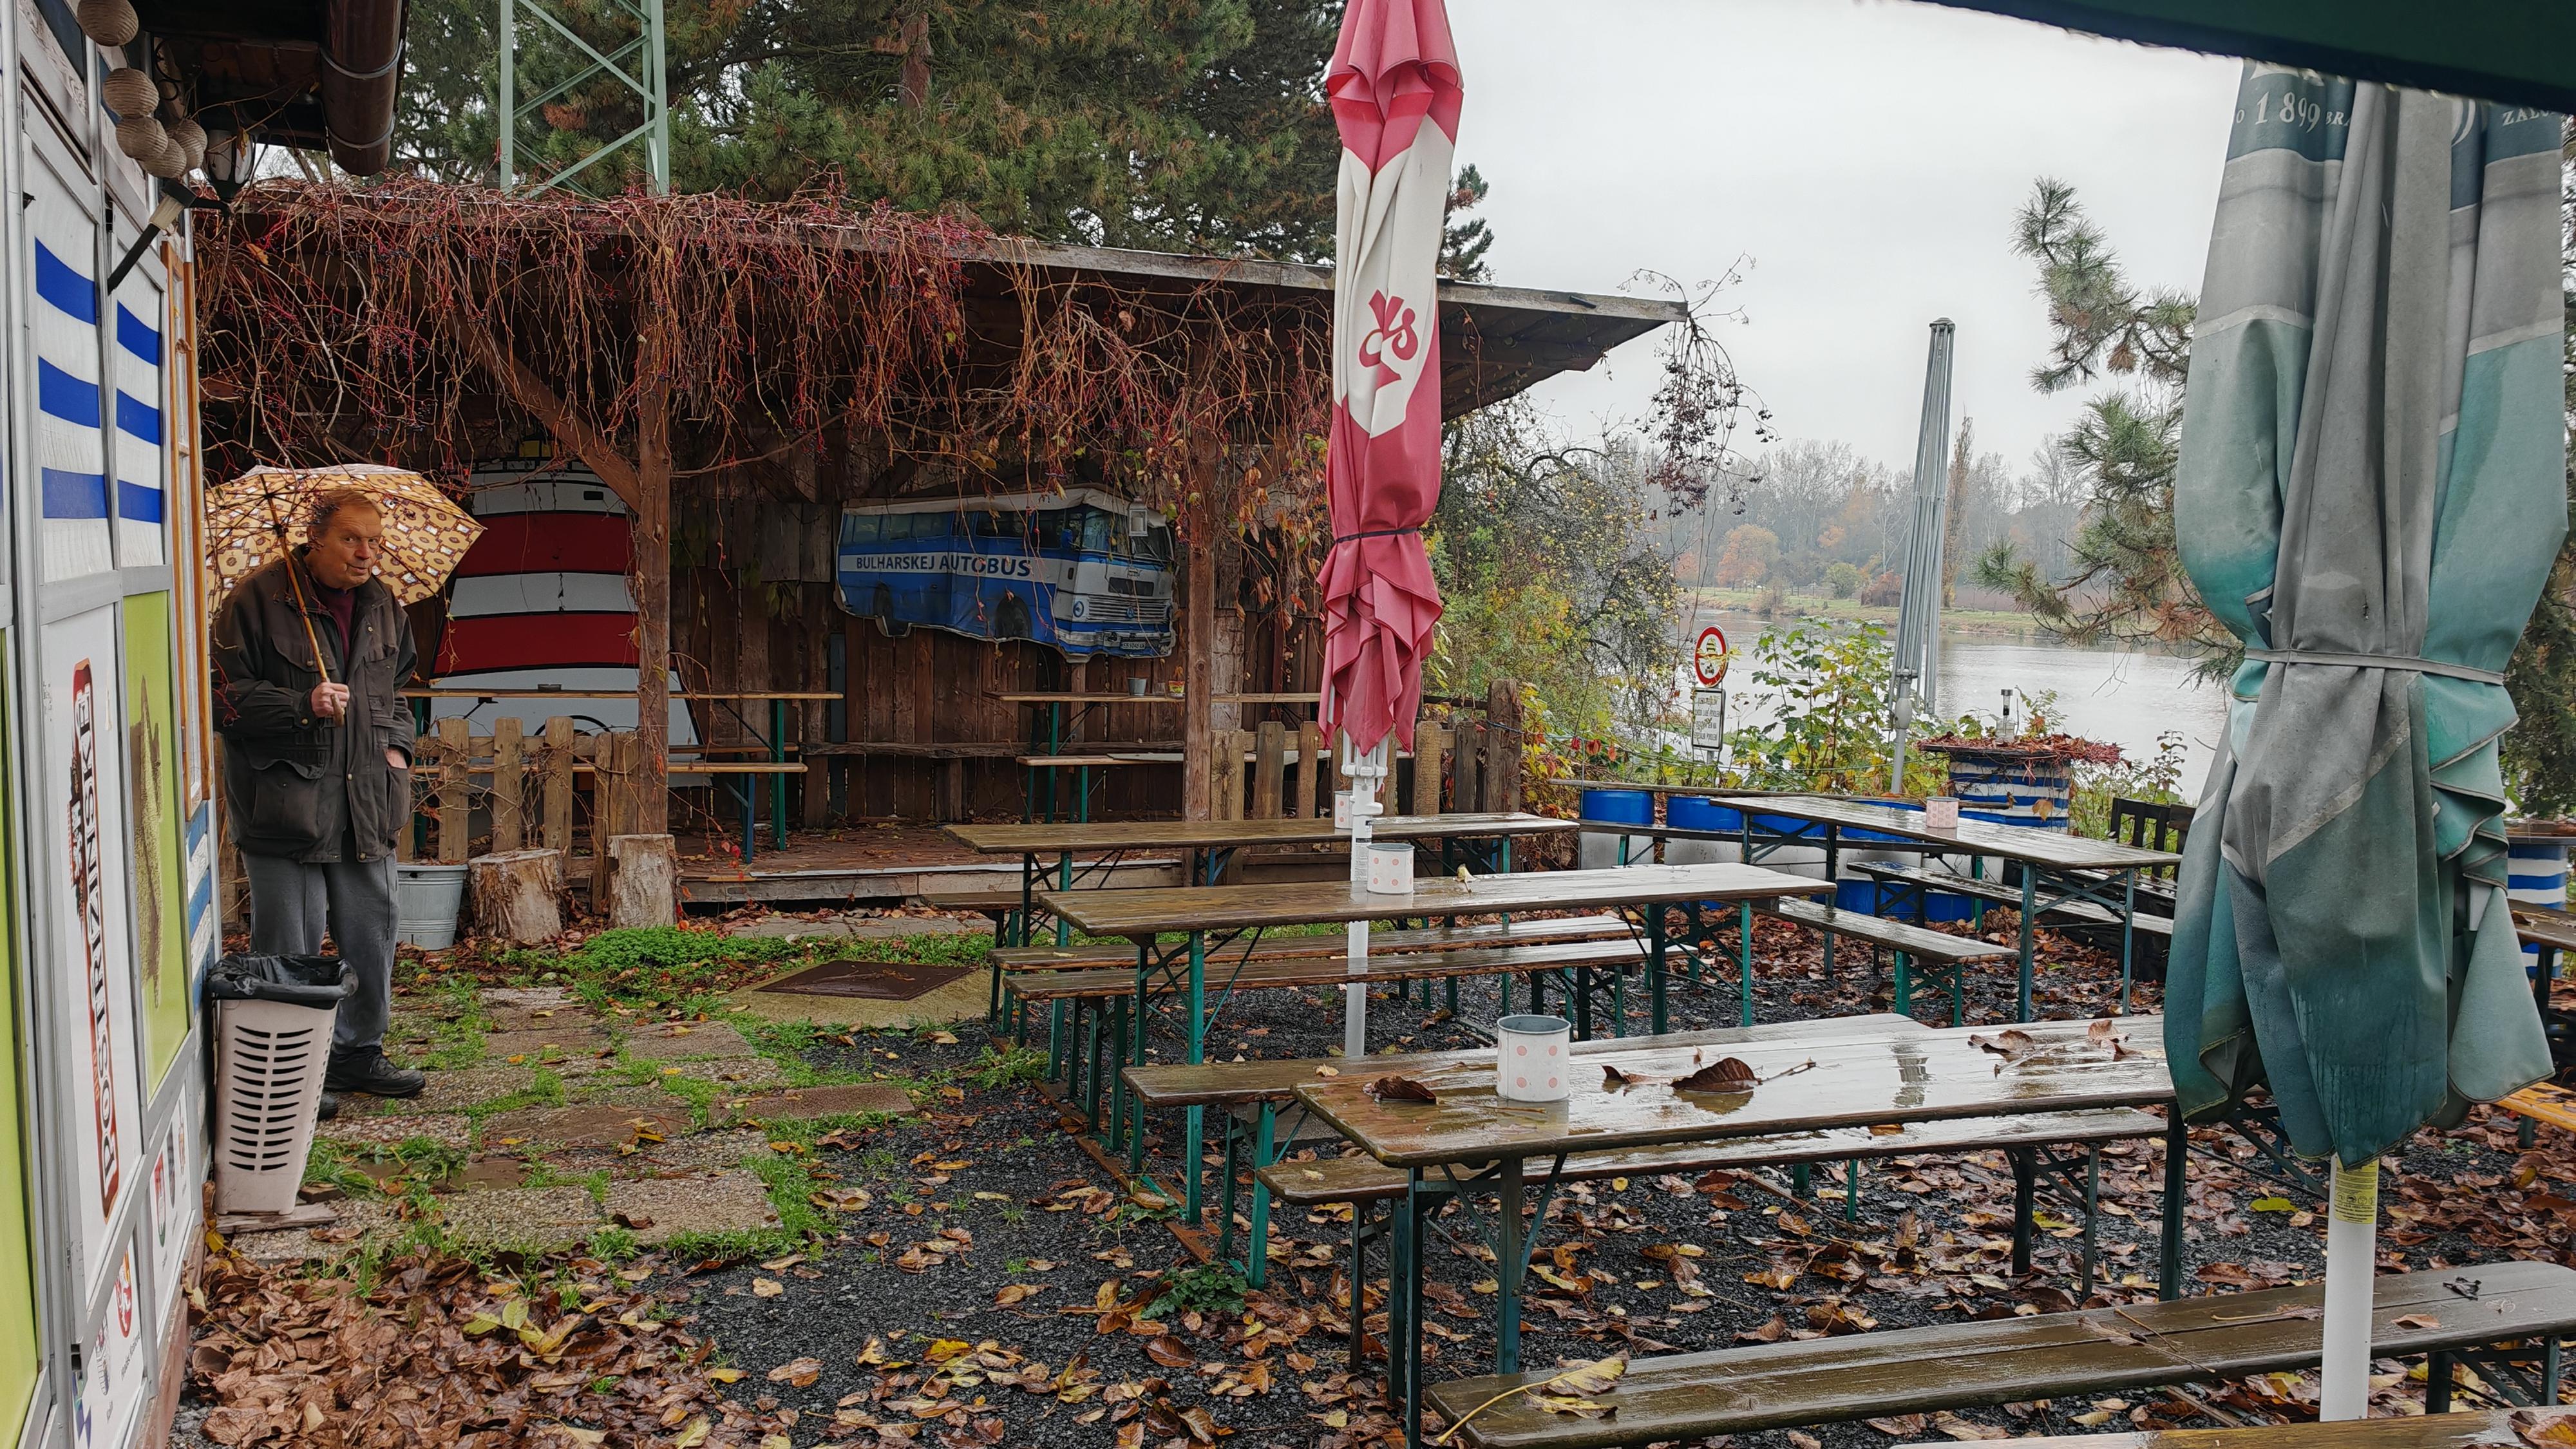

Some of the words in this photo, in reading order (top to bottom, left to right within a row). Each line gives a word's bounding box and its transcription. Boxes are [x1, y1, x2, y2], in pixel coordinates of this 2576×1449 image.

[2254, 91, 2321, 134] 1899
[857, 555, 935, 570] BULHARSKEJ
[939, 555, 1031, 577] AUTOBUS
